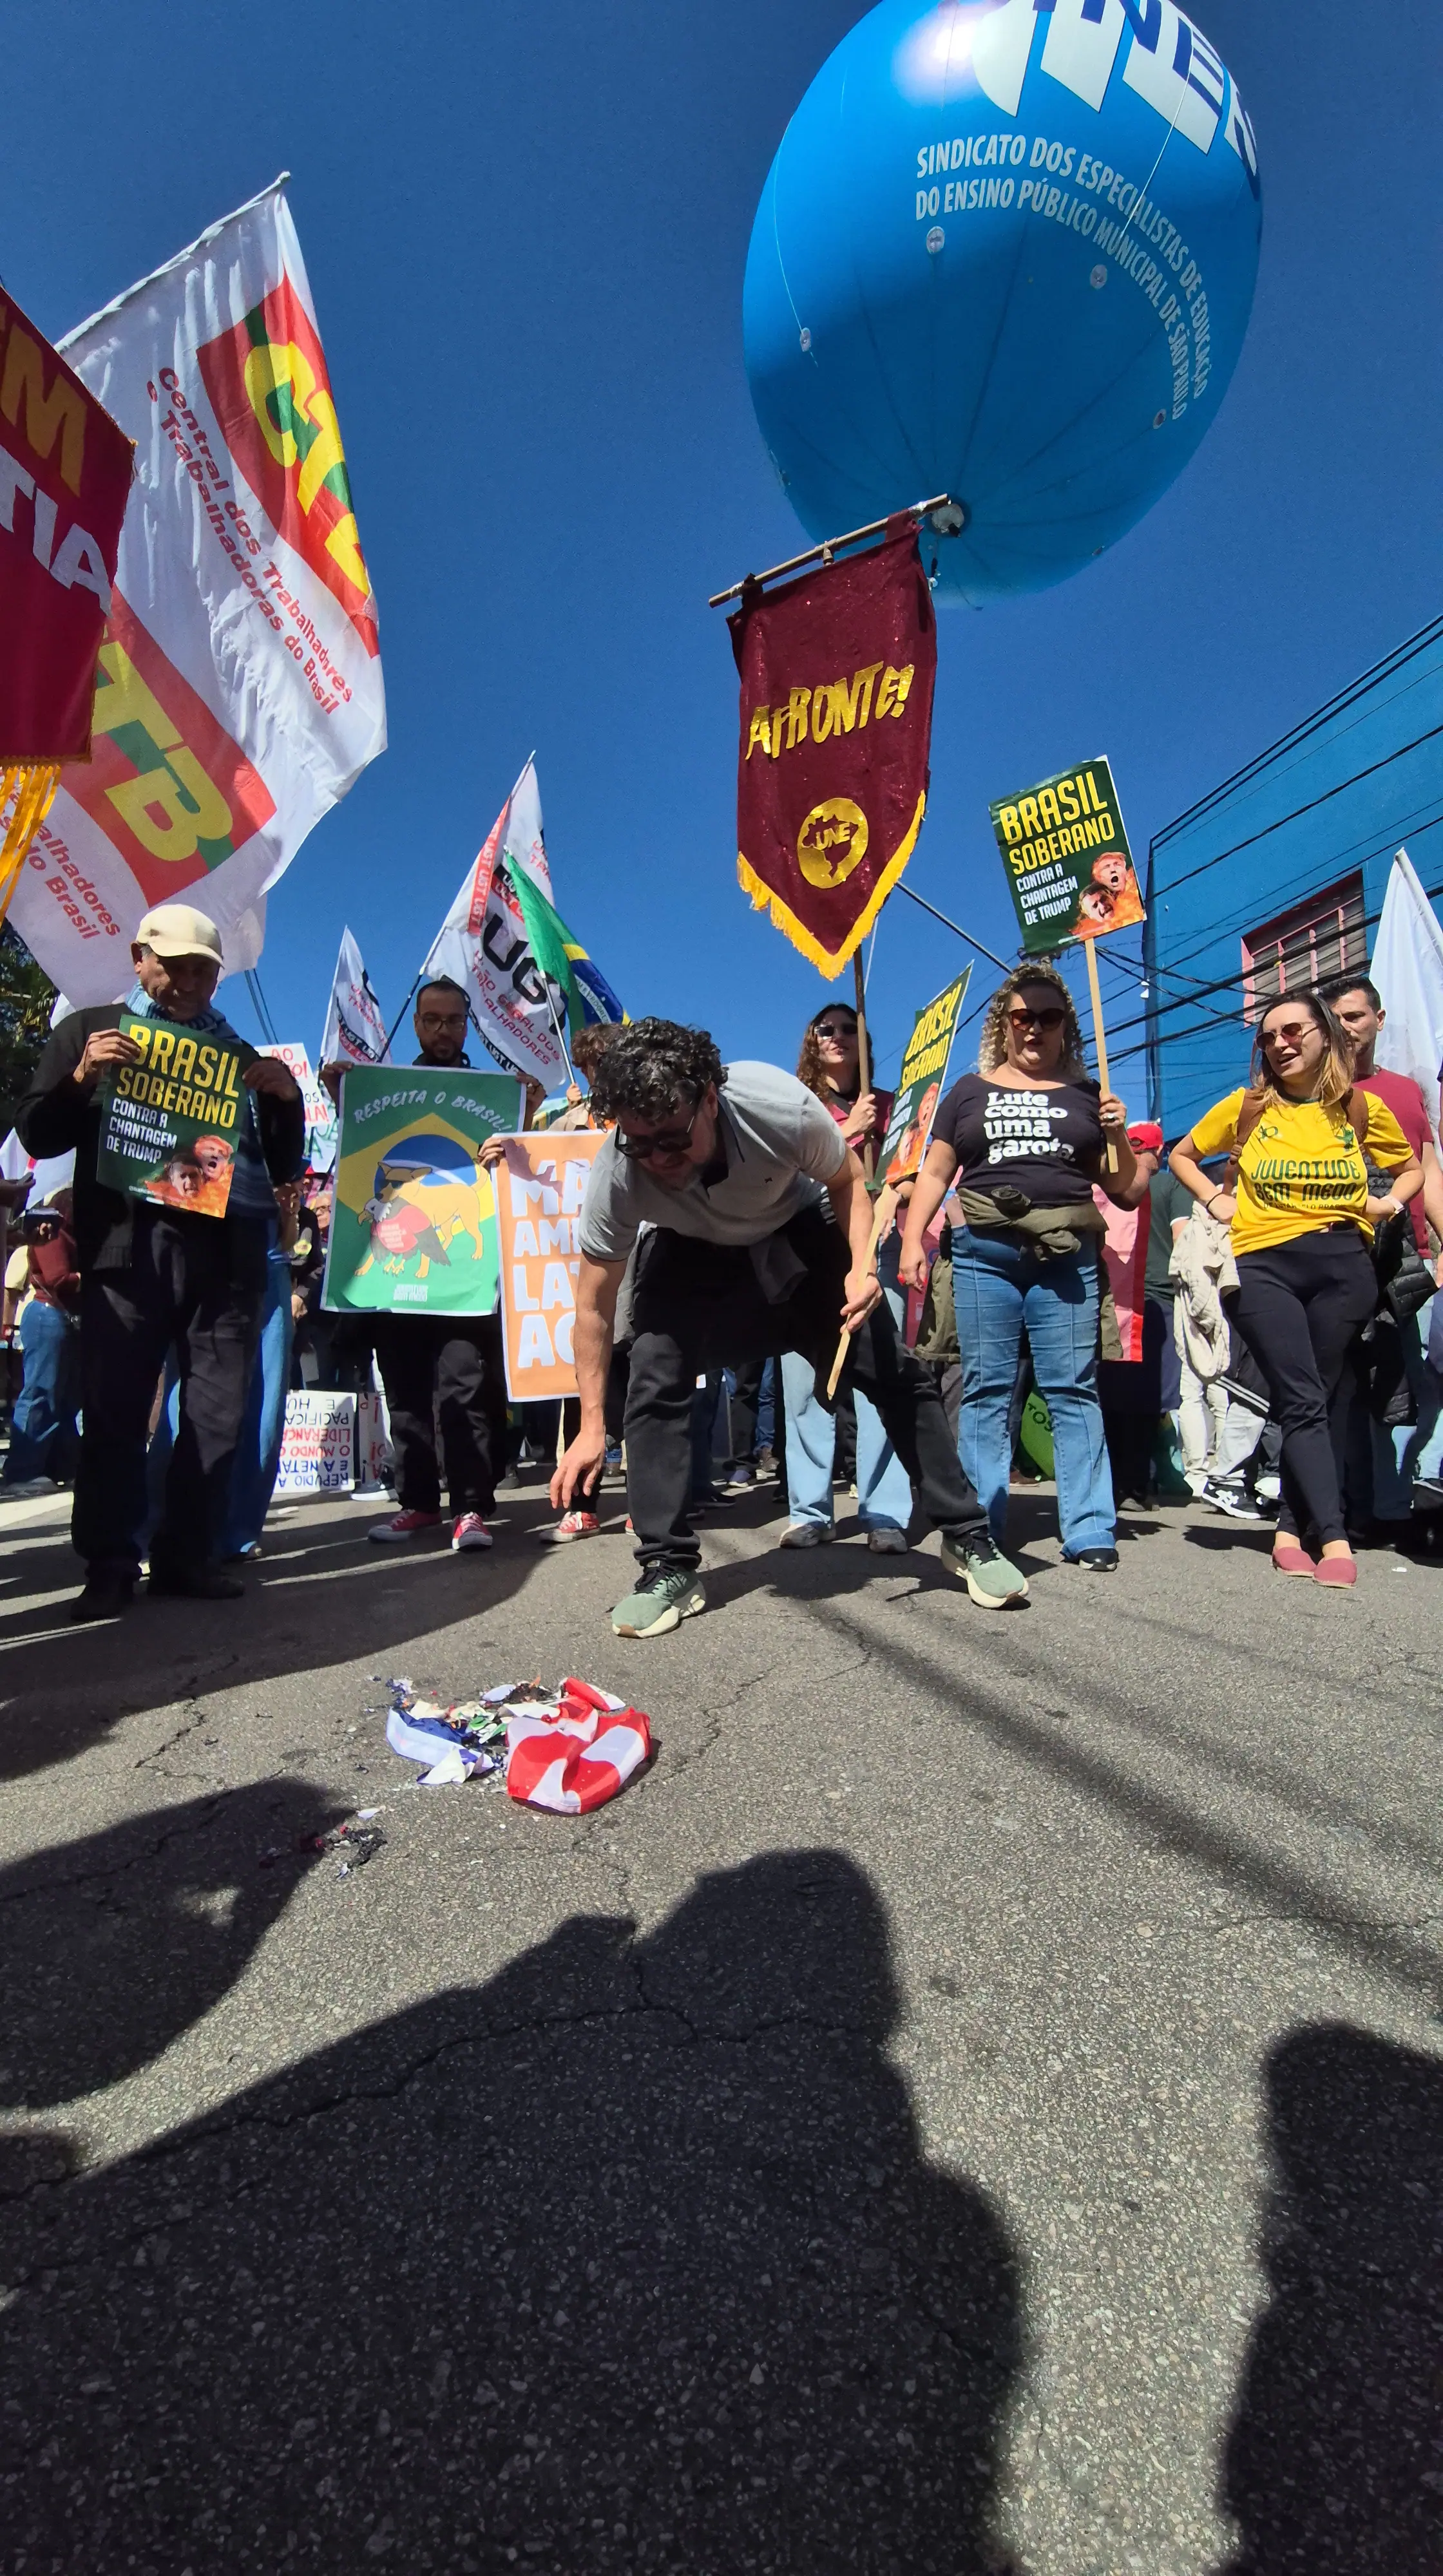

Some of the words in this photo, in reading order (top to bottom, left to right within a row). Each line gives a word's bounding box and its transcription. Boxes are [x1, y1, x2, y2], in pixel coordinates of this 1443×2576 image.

[917, 135, 1026, 178] SINDICATO
[1029, 137, 1076, 177] DOS
[1075, 153, 1189, 272] ESPECIALISTAS
[1179, 260, 1203, 301] DE
[916, 186, 940, 220] DO
[944, 178, 1015, 213] ENSINO
[1017, 177, 1098, 237] PÚBLICO
[1093, 216, 1169, 308] MUNICIPAL
[1159, 293, 1181, 332] DE
[158, 367, 230, 492] Central
[224, 500, 262, 556] dos
[262, 561, 353, 703] Trabalhadores
[160, 409, 284, 631] Trabalhadoras
[284, 634, 304, 661] do
[303, 657, 340, 715] Brasil
[744, 661, 915, 760] AFRONTE!
[999, 771, 1108, 845] BRASIL
[815, 822, 851, 851] UNE
[1009, 813, 1115, 875] SOBERANO
[1016, 867, 1055, 893] CONTRA
[1055, 863, 1064, 877] A
[1020, 876, 1078, 909] CHANTAGEM
[44, 875, 101, 940] Brasil
[1024, 909, 1038, 925] DE
[1039, 897, 1072, 922] TRUMP
[905, 981, 962, 1063] BRASIL
[129, 1025, 240, 1098] BRASIL
[537, 1032, 561, 1061] DOS
[289, 1061, 309, 1079] O!
[899, 1033, 950, 1097] SOBERANO
[112, 1097, 157, 1124] CONTRA
[160, 1113, 169, 1128] A
[116, 1066, 237, 1128] SOBERANO
[353, 1089, 428, 1124] RESPEITA
[434, 1090, 447, 1105] O
[451, 1095, 513, 1132] BRASIL!
[984, 1105, 1068, 1118] como
[987, 1091, 1049, 1106] Lute
[109, 1115, 178, 1150] CHANTAGEM
[983, 1119, 1052, 1139] uma
[106, 1135, 120, 1153] DE
[123, 1139, 162, 1164] TRUMP
[988, 1137, 1076, 1164] garota
[281, 1459, 319, 1473] NETA
[323, 1459, 336, 1473] A
